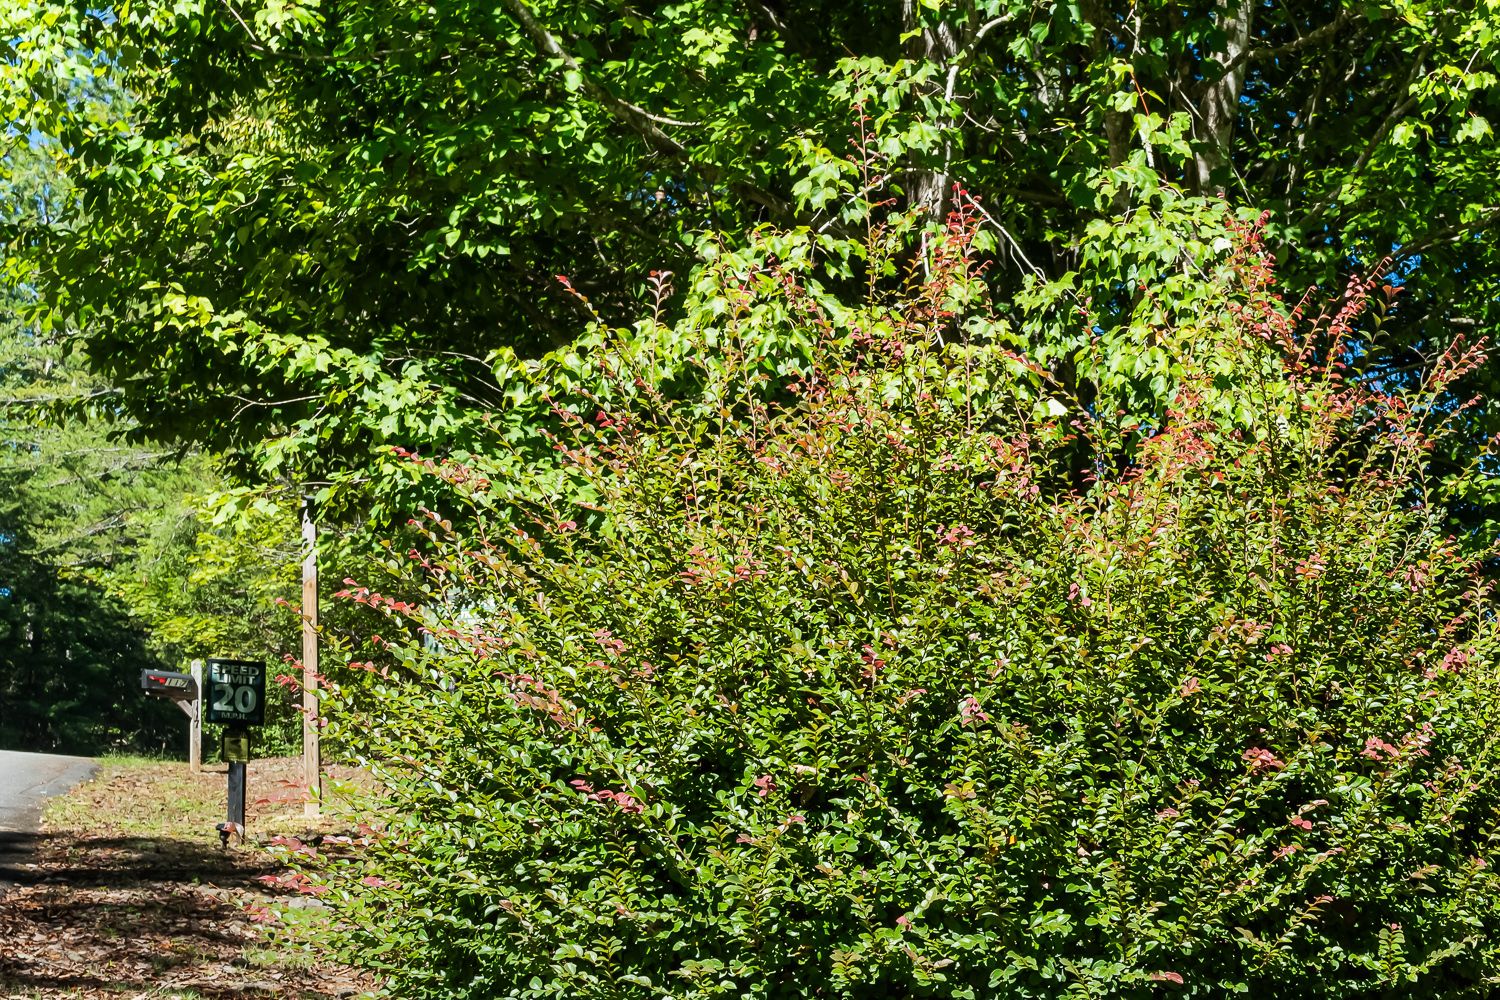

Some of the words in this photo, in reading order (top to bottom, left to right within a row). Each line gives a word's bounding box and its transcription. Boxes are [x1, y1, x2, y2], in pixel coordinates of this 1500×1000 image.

[212, 663, 259, 676] SPEED
[216, 673, 255, 685] LIMIT
[213, 684, 257, 713] 20
[221, 712, 248, 720] M.P.H.
